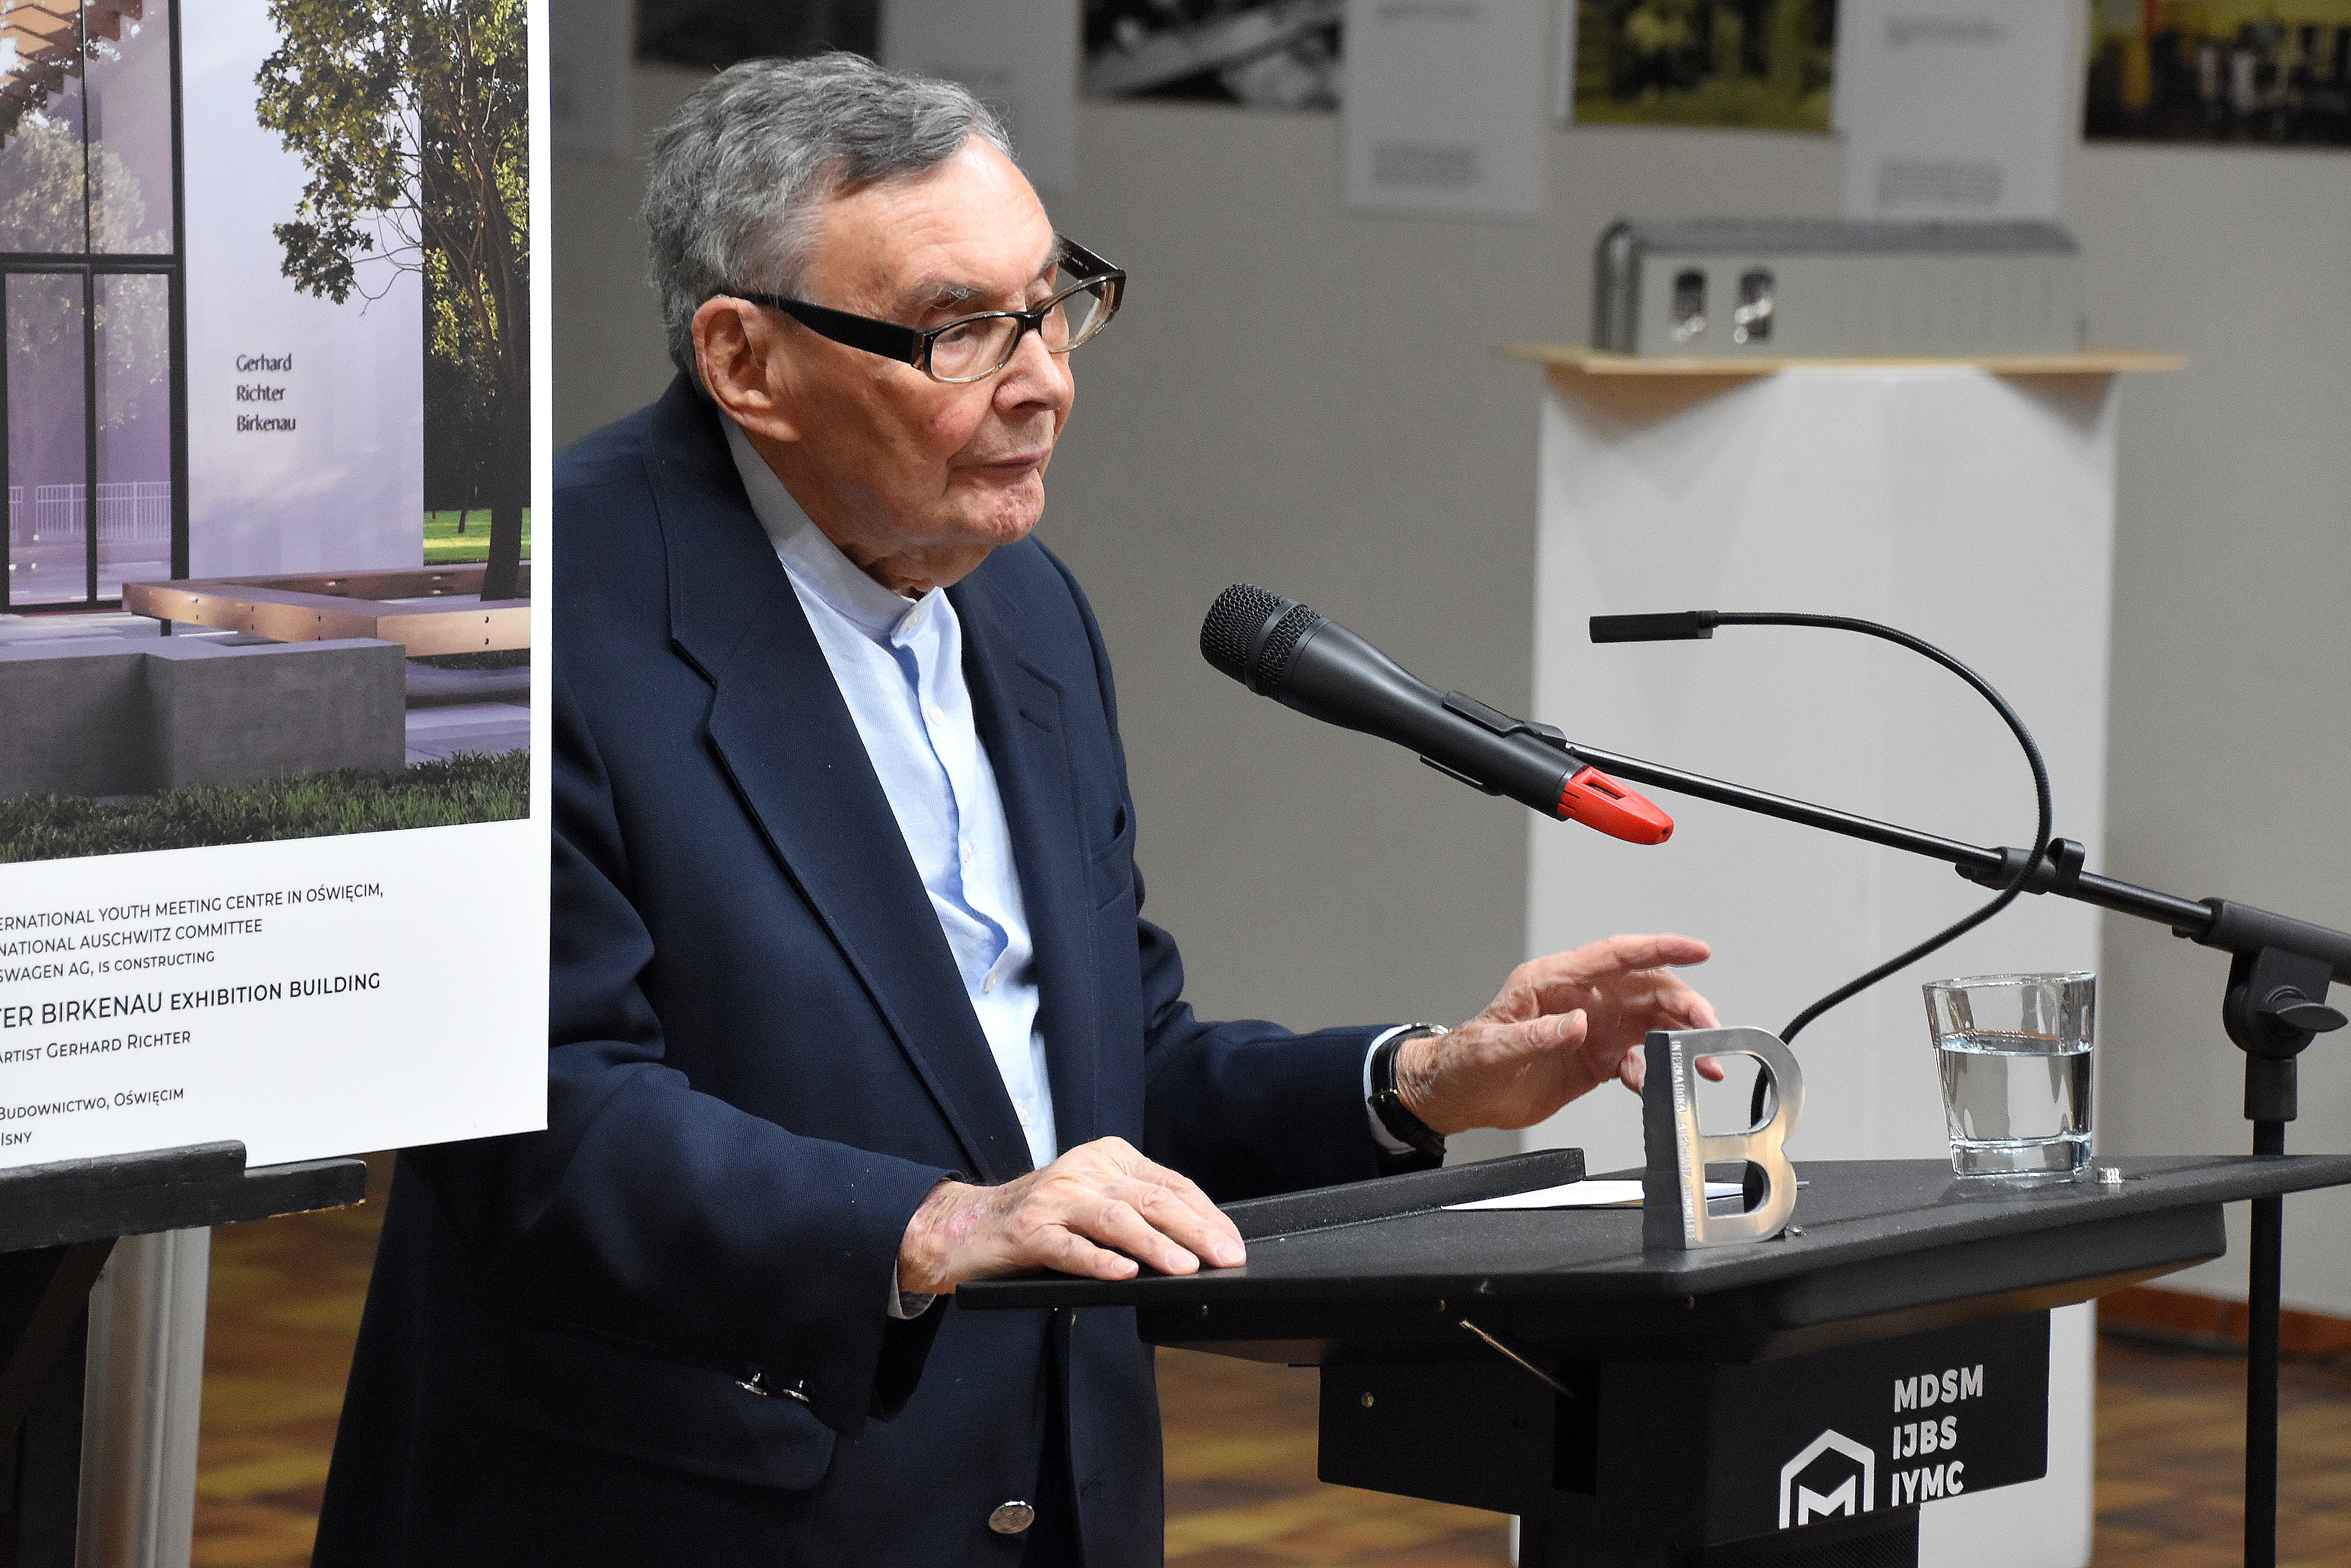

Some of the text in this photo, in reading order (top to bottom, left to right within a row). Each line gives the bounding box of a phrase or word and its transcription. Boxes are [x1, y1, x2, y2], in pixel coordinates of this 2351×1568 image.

[236, 353, 292, 372] Gerhard
[236, 383, 286, 401] Richter
[236, 414, 296, 431] Birkenau
[99, 904, 150, 921] YOUTH
[155, 898, 221, 916] MEETING
[226, 892, 283, 910] CENTRE
[288, 890, 301, 904] IN
[306, 883, 384, 902] OŚWIĘCIM,
[80, 927, 171, 949] AUSCHWITZ
[175, 918, 263, 940] COMMITTEE
[69, 960, 94, 977] AG,
[99, 961, 110, 973] IS
[114, 951, 215, 972] CONSTRUCTING
[0, 972, 381, 1028] ER BIRKENAU EXHIBITION BUILDING
[1894, 1364, 1984, 1413] MDSM
[1893, 1416, 1958, 1460] IJBS
[1891, 1461, 1964, 1508] IYMC
